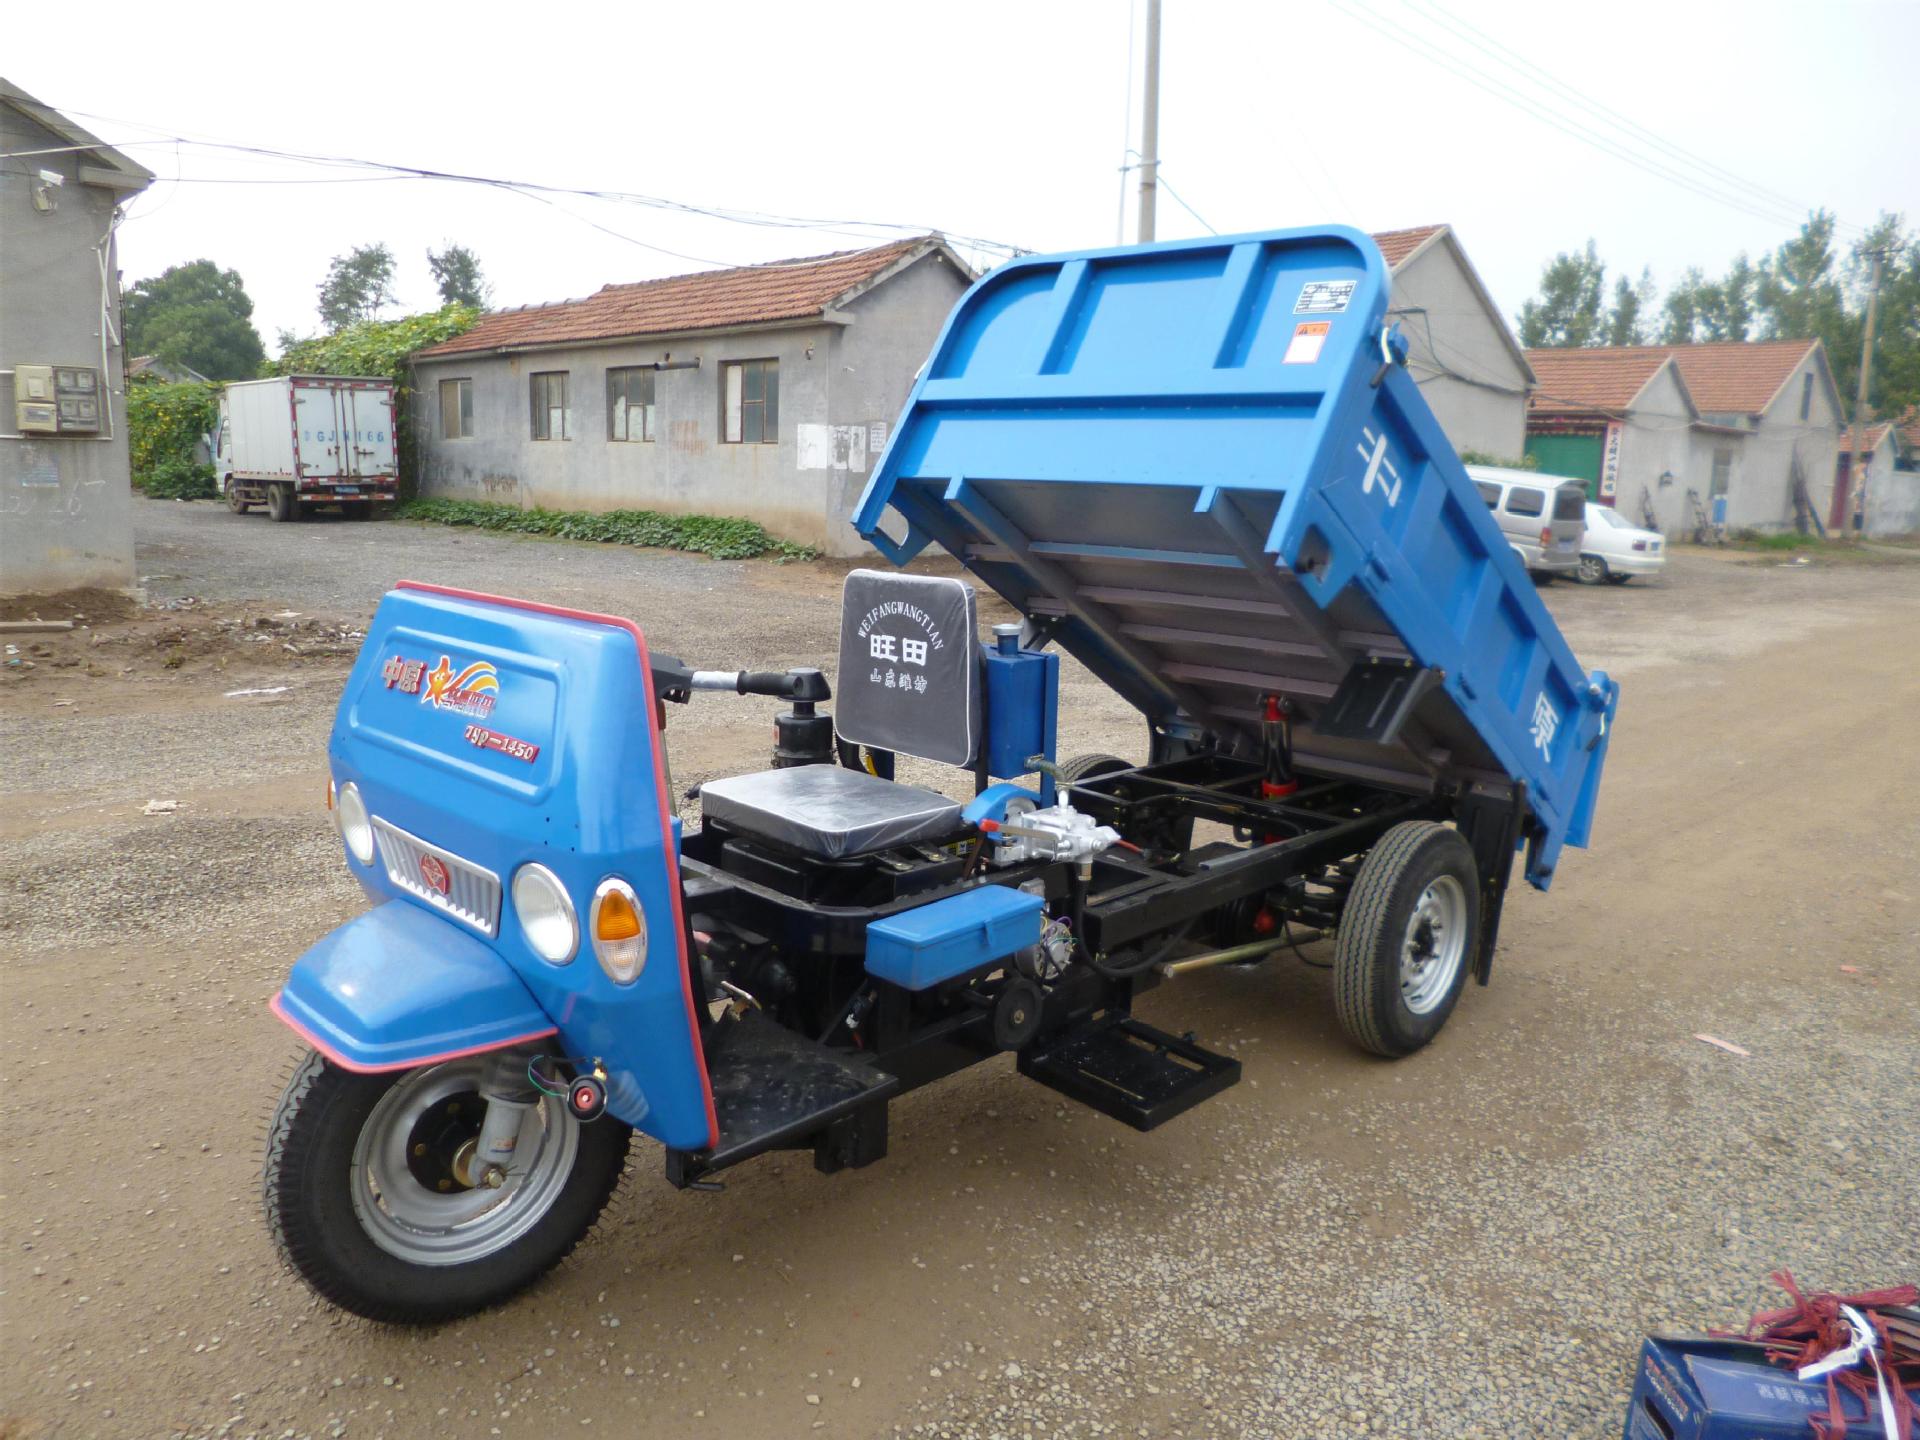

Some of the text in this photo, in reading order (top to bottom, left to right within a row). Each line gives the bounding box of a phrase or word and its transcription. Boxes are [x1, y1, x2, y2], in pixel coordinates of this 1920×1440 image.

[857, 601, 944, 651] WEIFANGWANGTIAN
[870, 633, 928, 667] 旺田
[382, 655, 428, 694] 中原
